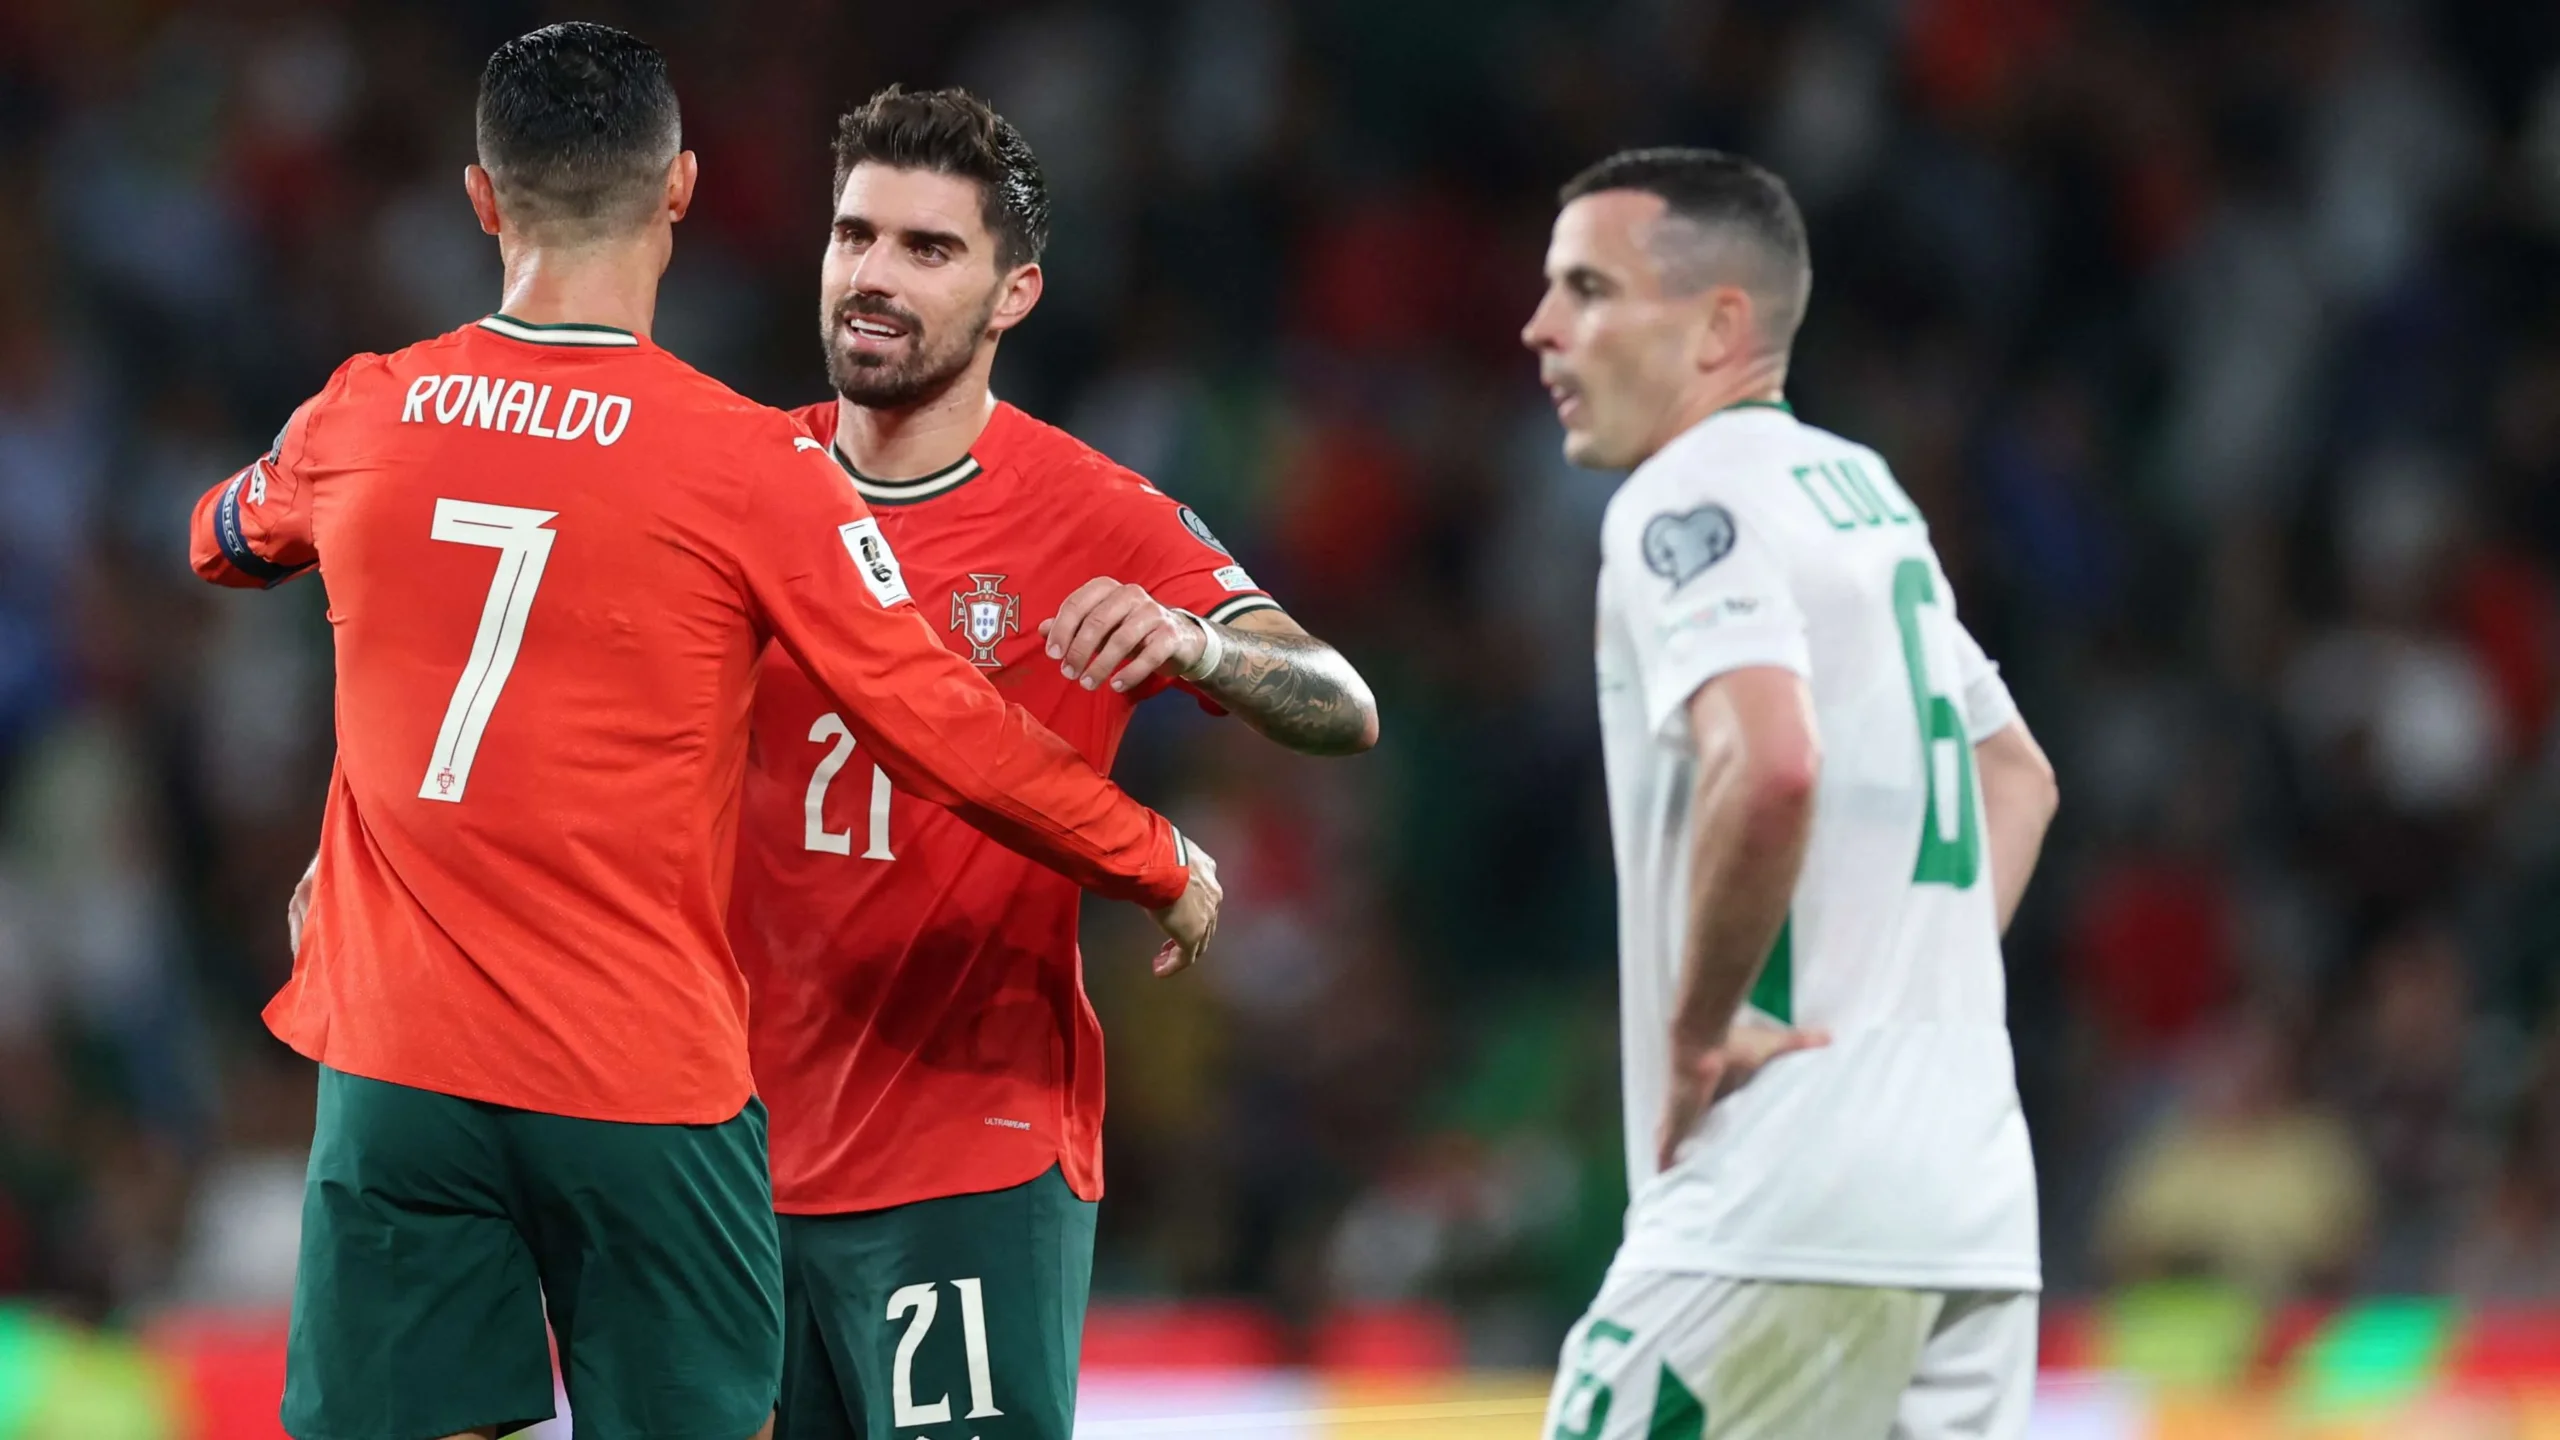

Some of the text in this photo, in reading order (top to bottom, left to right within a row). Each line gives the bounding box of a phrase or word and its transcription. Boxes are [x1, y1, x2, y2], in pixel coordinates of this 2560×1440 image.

[402, 373, 632, 446] RONALDO
[1791, 460, 1917, 530] CUL
[417, 497, 560, 803] 7
[1892, 558, 1980, 889] 6
[804, 712, 897, 861] 21
[984, 1117, 1031, 1130] ULTRAWEAVE
[886, 1277, 1005, 1428] 21
